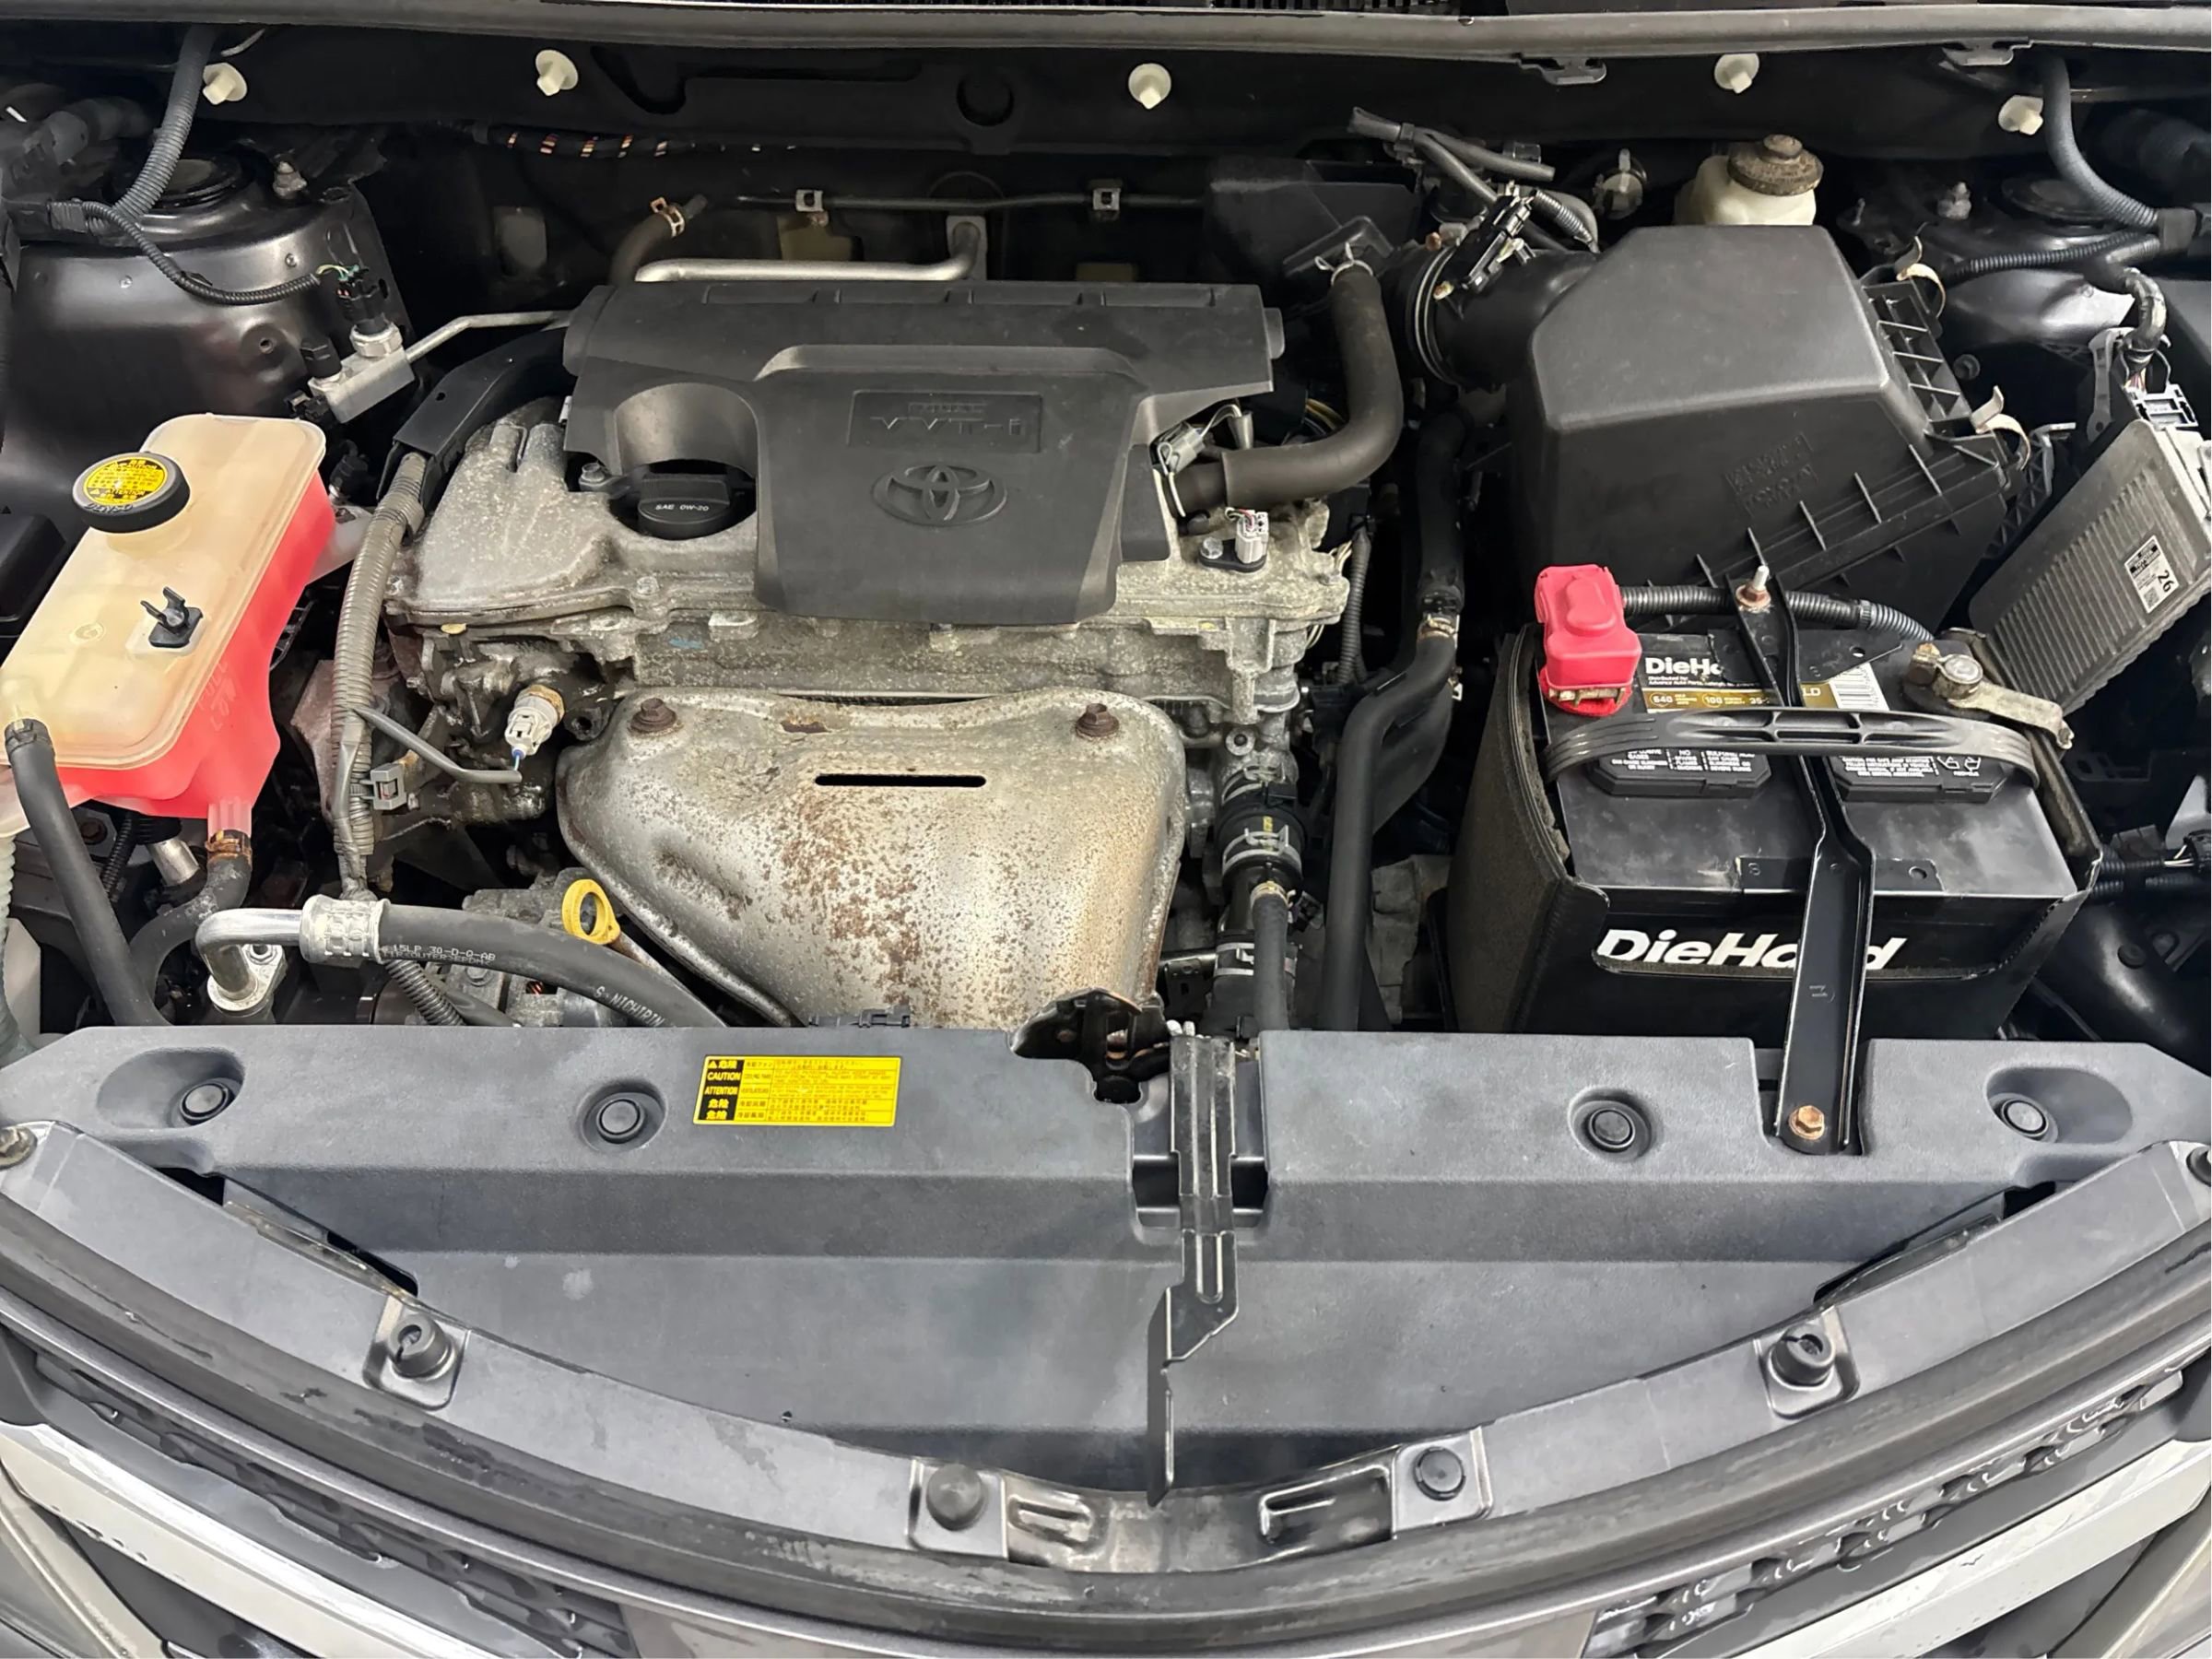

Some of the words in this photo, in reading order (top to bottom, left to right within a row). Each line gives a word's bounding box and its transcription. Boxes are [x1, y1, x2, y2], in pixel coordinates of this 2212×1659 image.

[2157, 570, 2175, 593] 26
[1597, 929, 1907, 970] DieHad
[707, 1072, 741, 1081] CAUTION
[704, 1087, 738, 1095] ATTENTION
